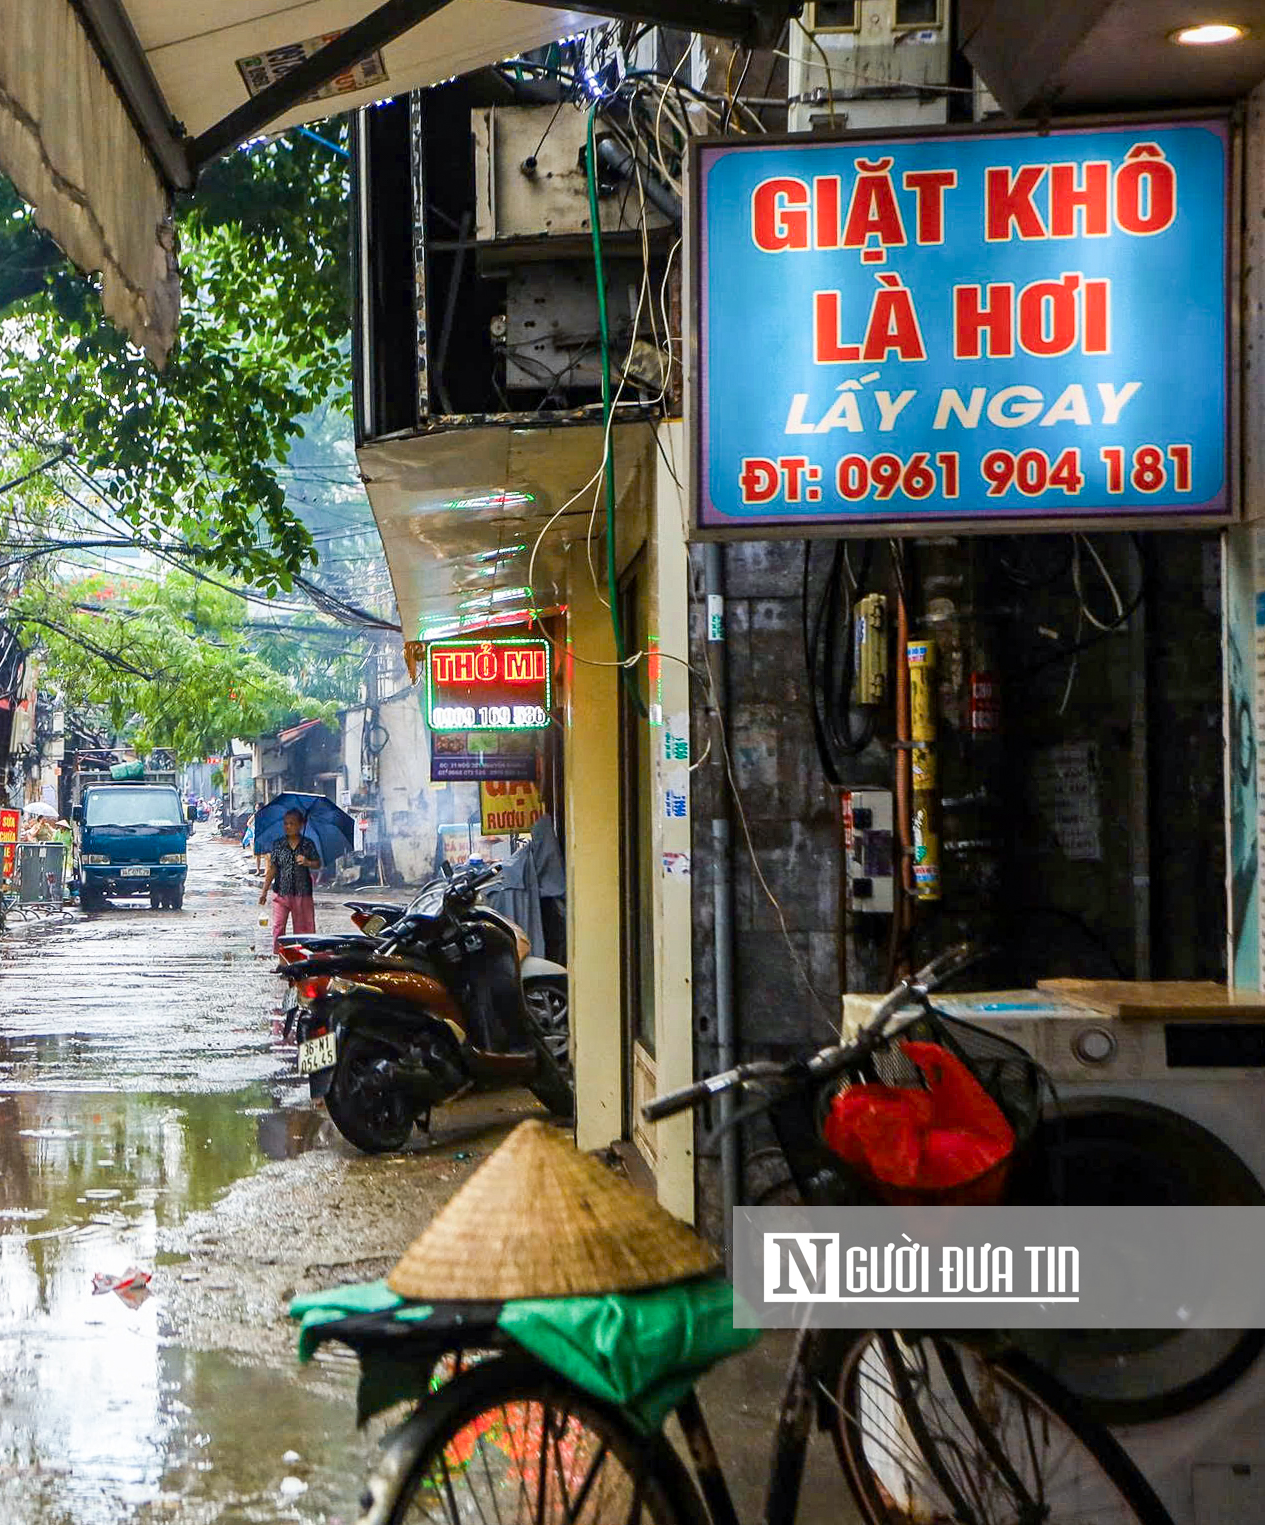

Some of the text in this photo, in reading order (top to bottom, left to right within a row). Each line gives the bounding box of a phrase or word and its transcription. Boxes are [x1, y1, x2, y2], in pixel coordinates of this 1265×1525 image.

[752, 143, 1177, 264] GIẶT KHÔ
[814, 271, 1111, 364] LÀ HƠI
[784, 372, 1141, 434] LẤY NGAY
[741, 445, 1192, 504] ĐT: 0961 904 181
[504, 651, 545, 681] MI
